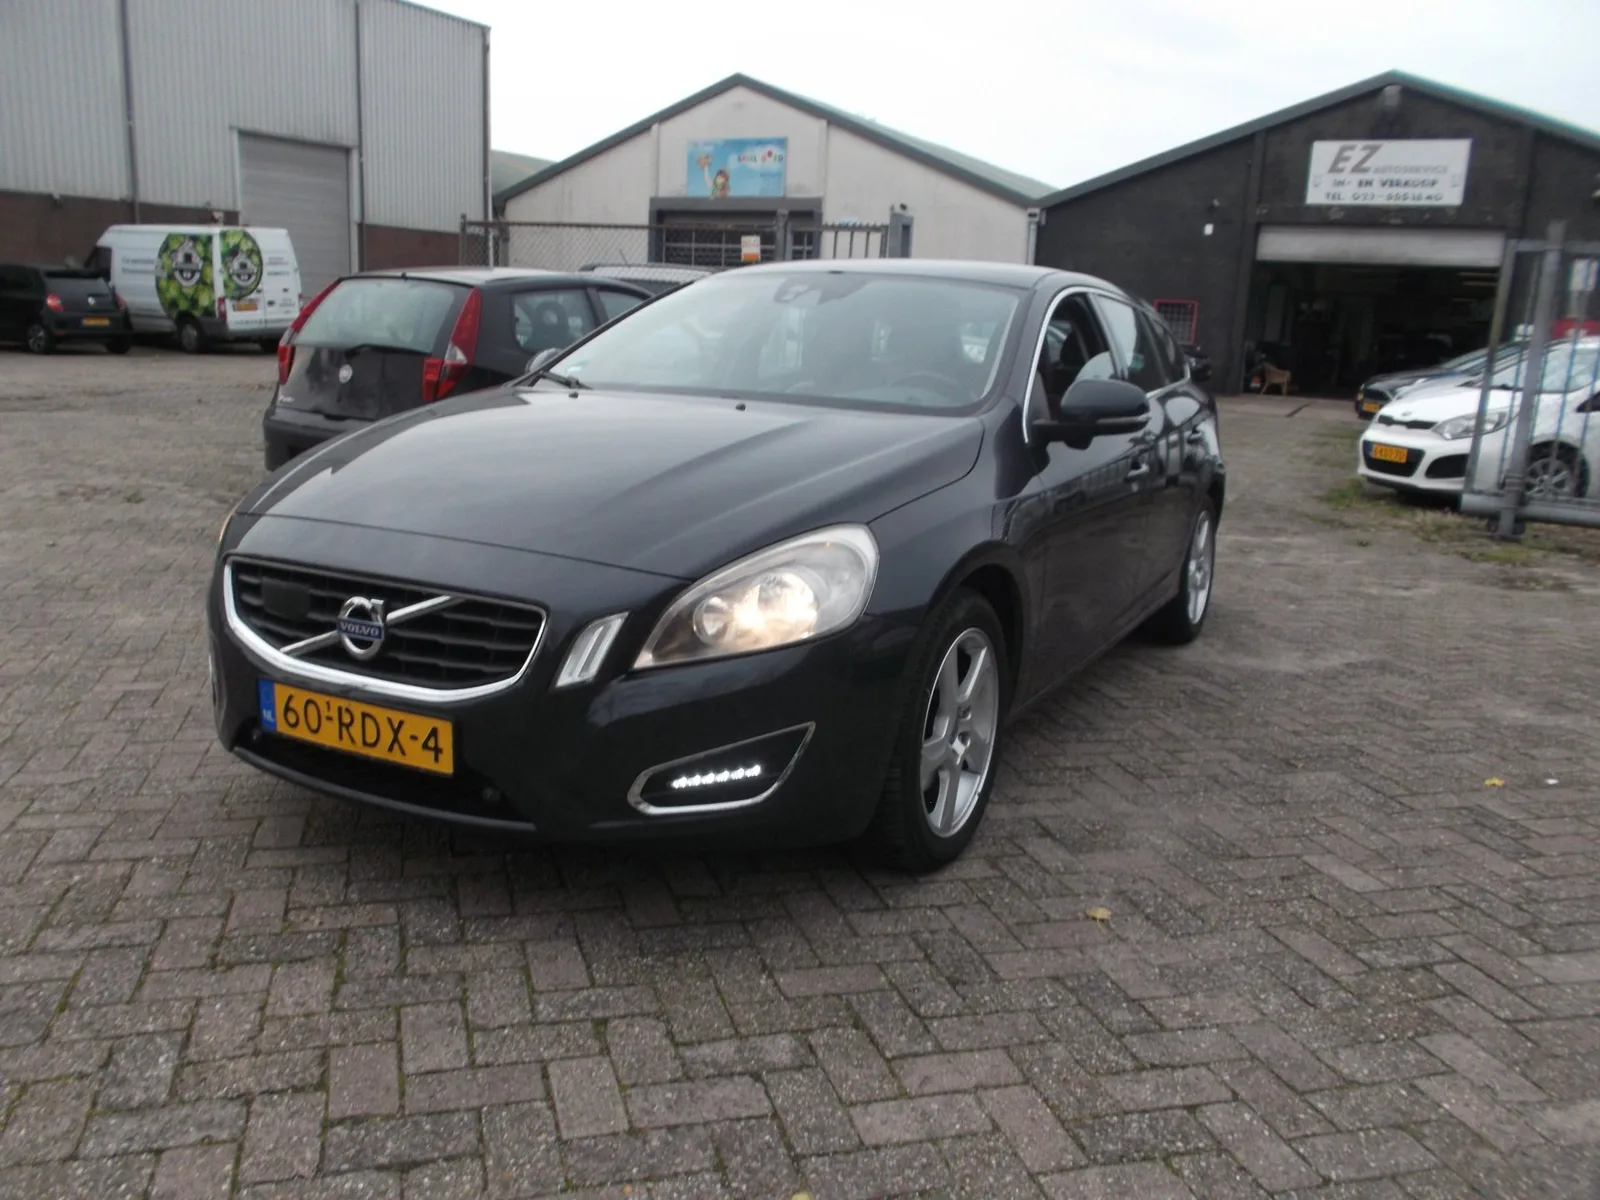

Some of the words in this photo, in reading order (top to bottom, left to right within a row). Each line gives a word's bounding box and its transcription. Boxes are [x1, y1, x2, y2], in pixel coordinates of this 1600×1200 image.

[1328, 144, 1384, 174] EZ
[1358, 178, 1373, 188] EN
[1380, 178, 1439, 188] VERKOOP
[340, 620, 379, 637] VOLVO
[263, 708, 274, 723] NL
